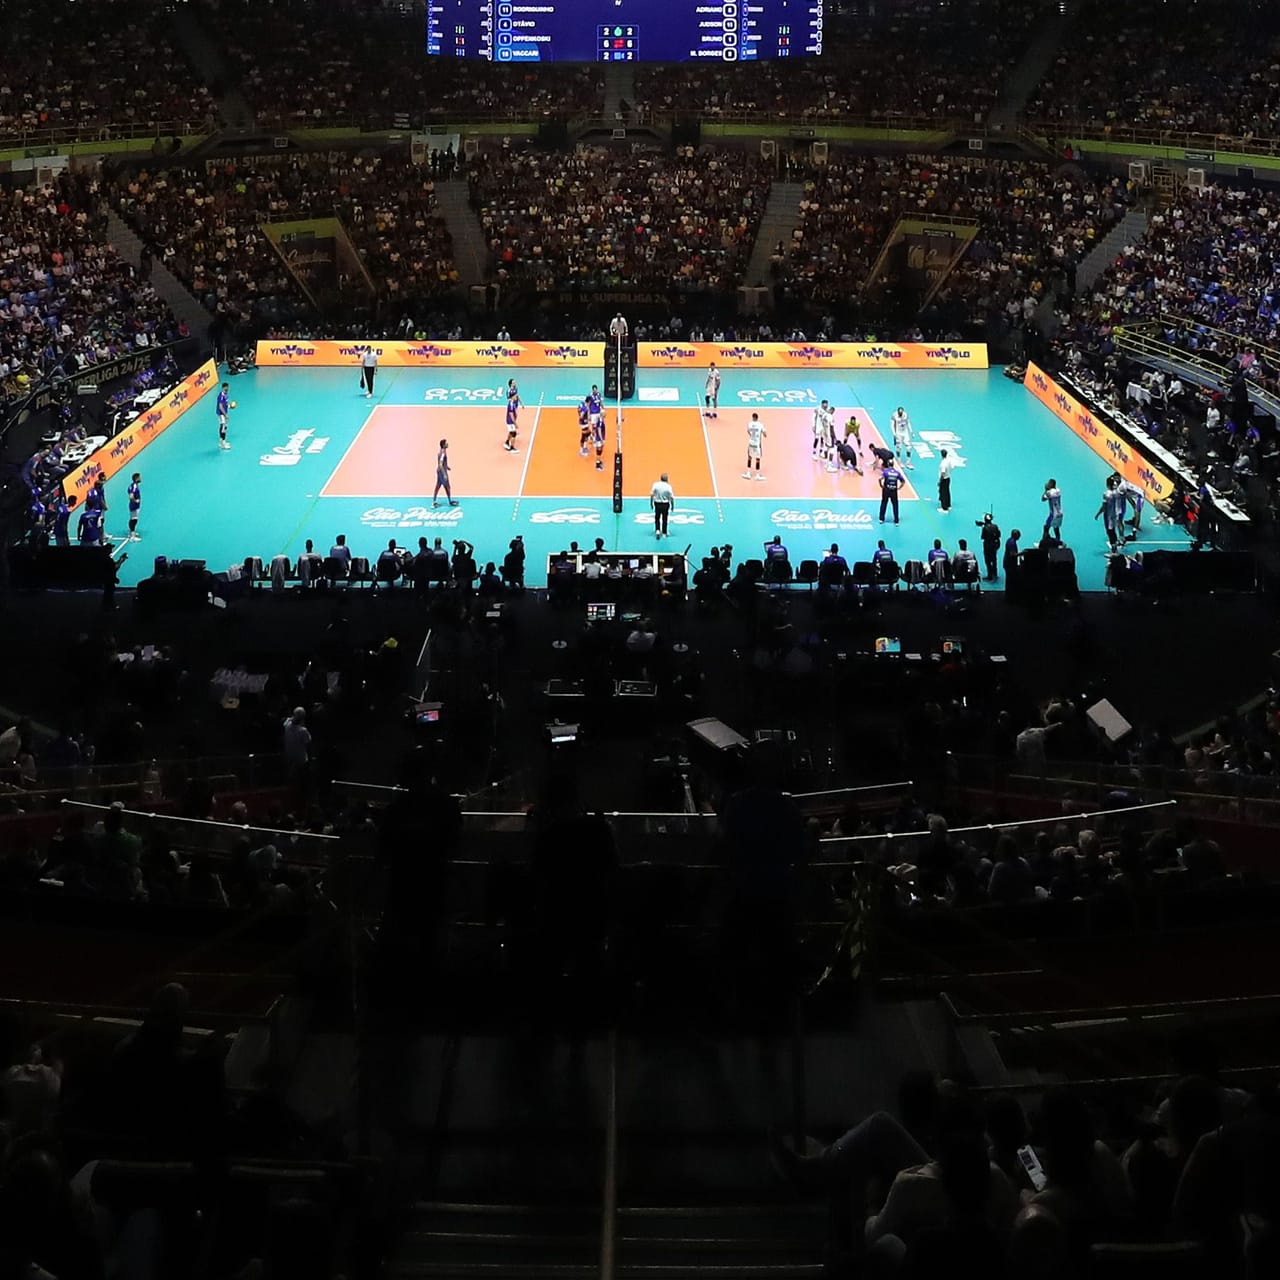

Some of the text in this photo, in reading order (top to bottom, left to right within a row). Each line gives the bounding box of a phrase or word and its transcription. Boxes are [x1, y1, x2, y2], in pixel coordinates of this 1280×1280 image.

[360, 506, 464, 521] São Paulo
[771, 508, 873, 523] São Paulo
